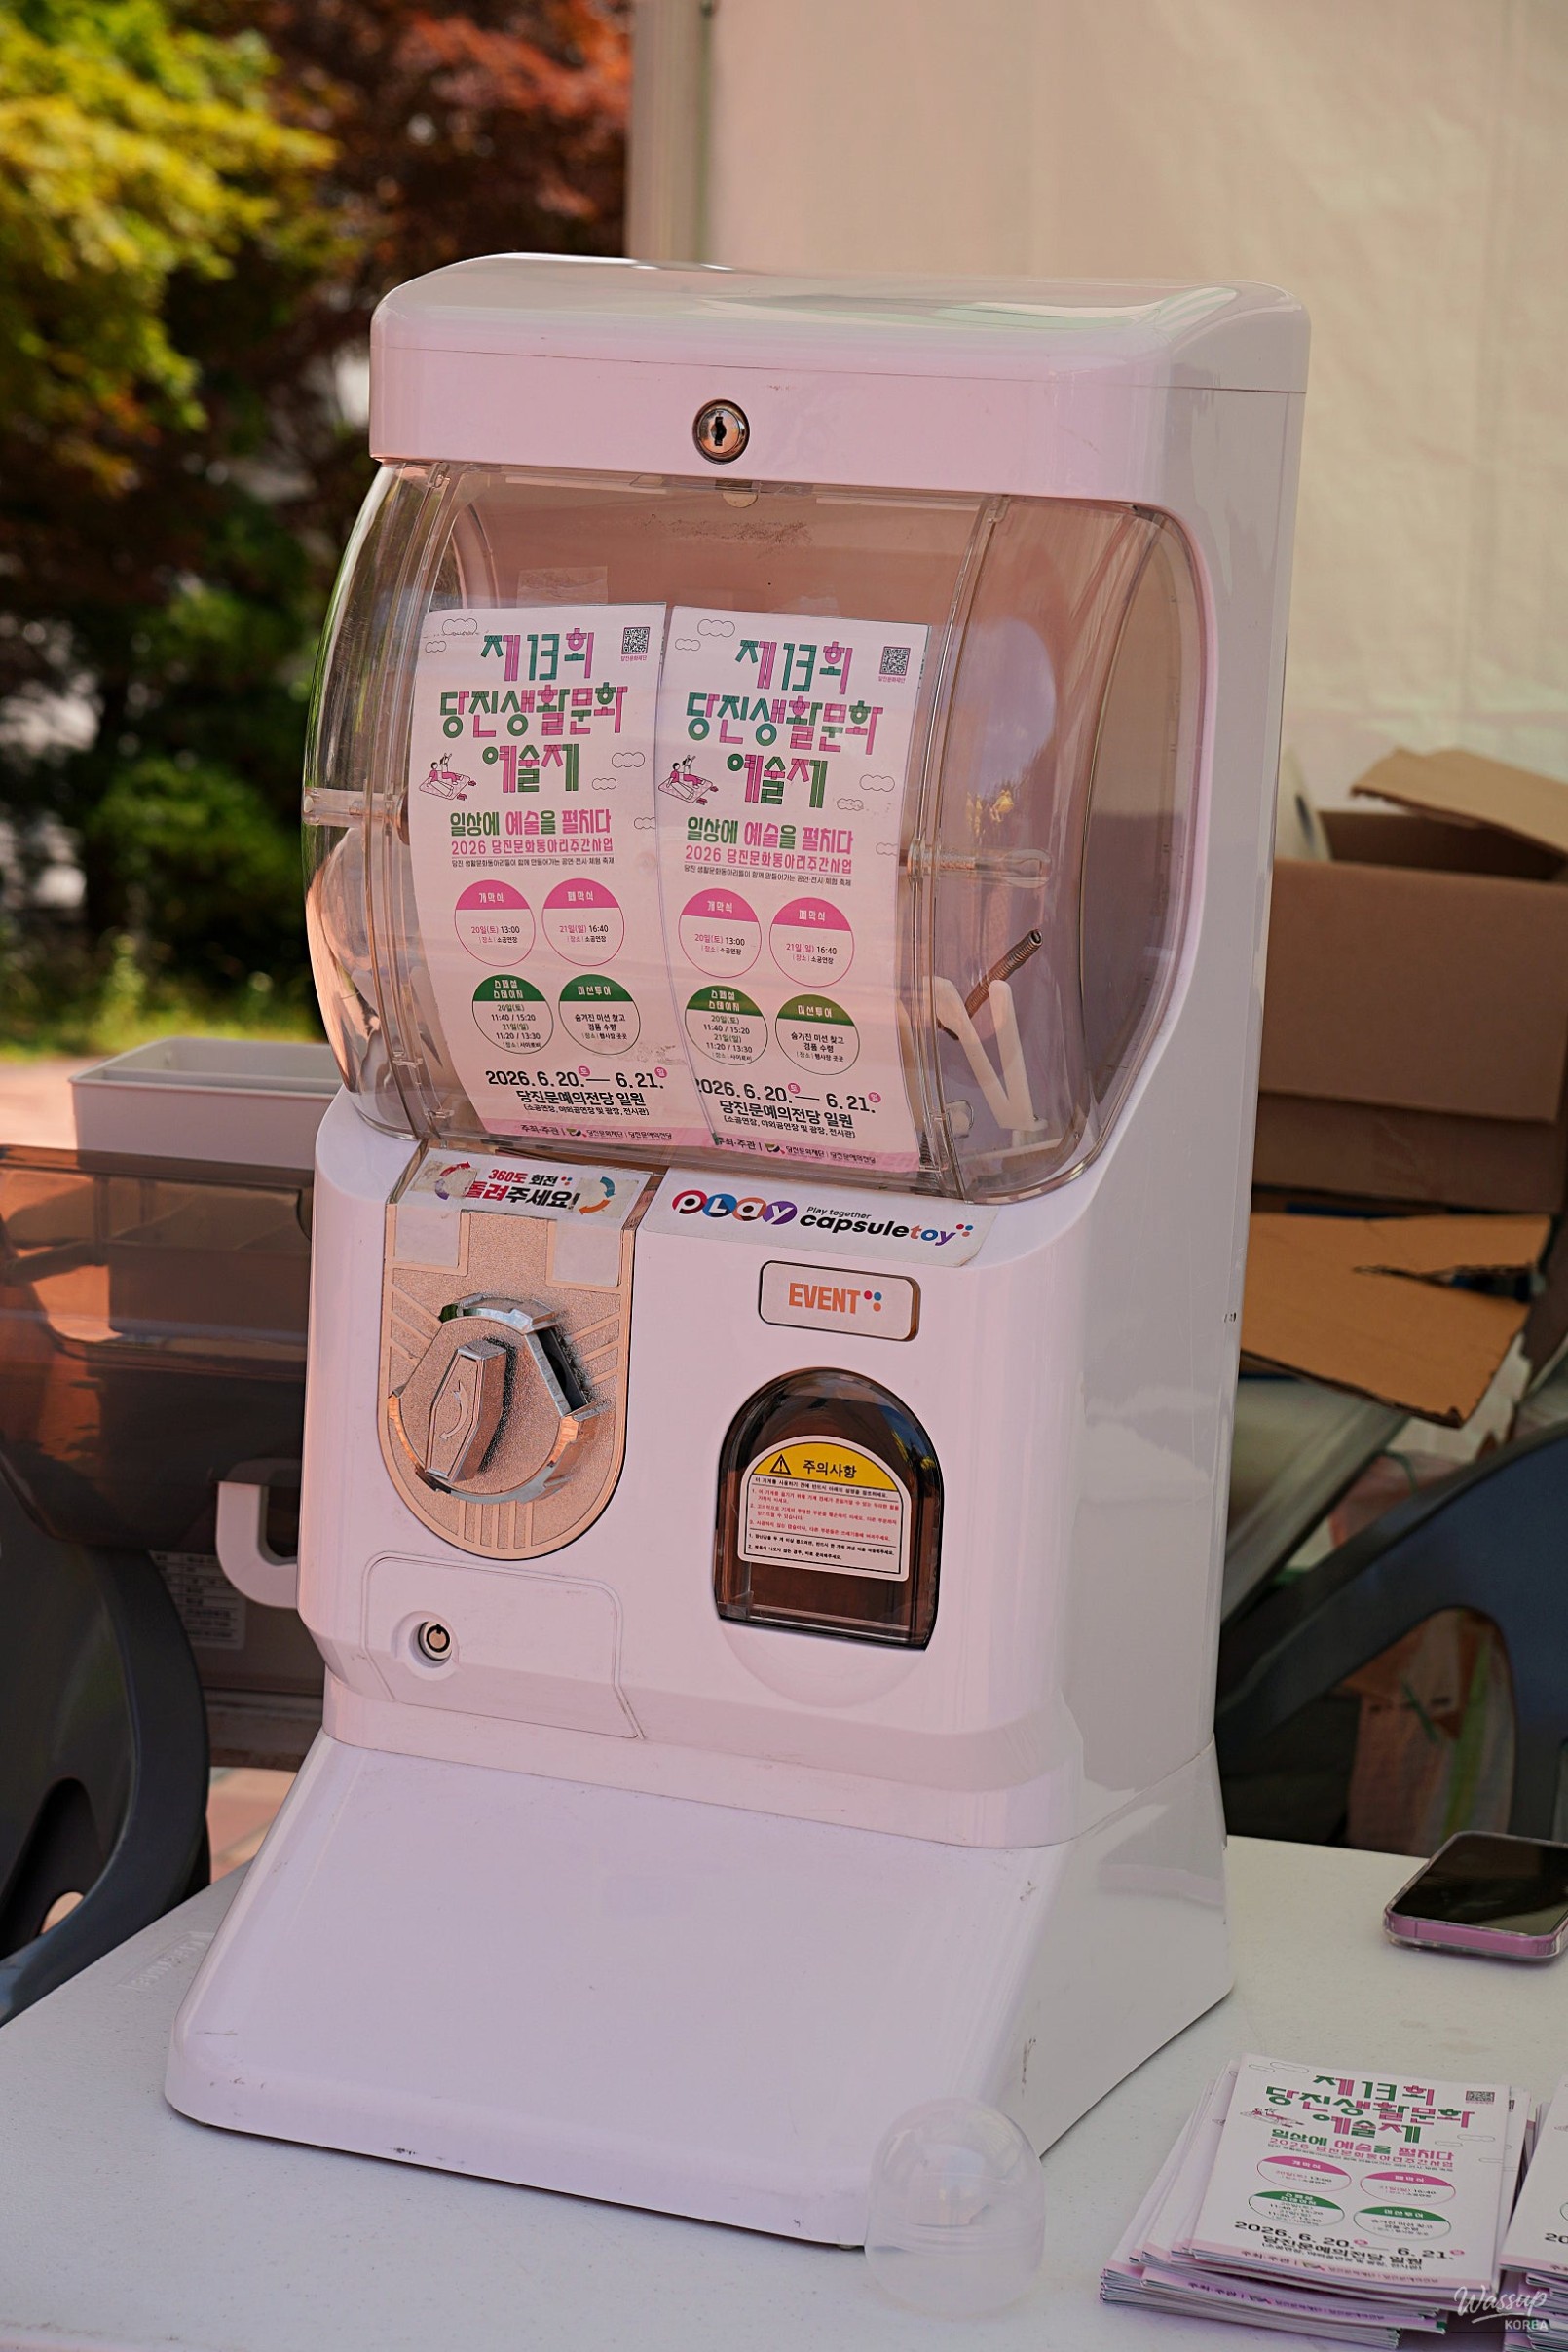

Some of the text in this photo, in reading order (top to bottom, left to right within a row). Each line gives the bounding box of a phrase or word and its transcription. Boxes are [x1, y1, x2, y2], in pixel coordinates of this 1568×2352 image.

[440, 682, 628, 738] 당진생활문화
[686, 692, 884, 755] 당진생활문화
[482, 744, 579, 793] 예술제
[727, 754, 828, 808] 예술제
[450, 809, 612, 837] 일상에 예술을 펼치다
[688, 816, 853, 855] 일상에 예술을 펼치다
[451, 838, 613, 855] 2026 당진문화동아리주간사업
[686, 845, 851, 874] 2026 당진문화동아리주간사업
[725, 937, 746, 946] 13:00
[596, 1014, 611, 1023] 미션
[703, 1024, 723, 1032] 11:40
[732, 1045, 752, 1054] 13:30
[814, 1034, 828, 1044] 미션
[516, 1091, 647, 1106] 당진문예의전당 일원
[719, 1101, 853, 1128] 당진문예의전당 일원
[488, 1169, 559, 1187] 360도 회전
[807, 1206, 872, 1219] Play together
[800, 1215, 956, 1247] capsuletoy
[789, 1282, 861, 1315] EVENT
[803, 1459, 857, 1478] 주의사항
[1266, 2086, 1475, 2129] 당진생활문화
[1313, 2113, 1422, 2144] 예술제
[1269, 2137, 1309, 2149] 2026
[1272, 2129, 1328, 2147] 일상에
[1334, 2139, 1391, 2154] 예술을
[1399, 2147, 1455, 2160] 펼치다
